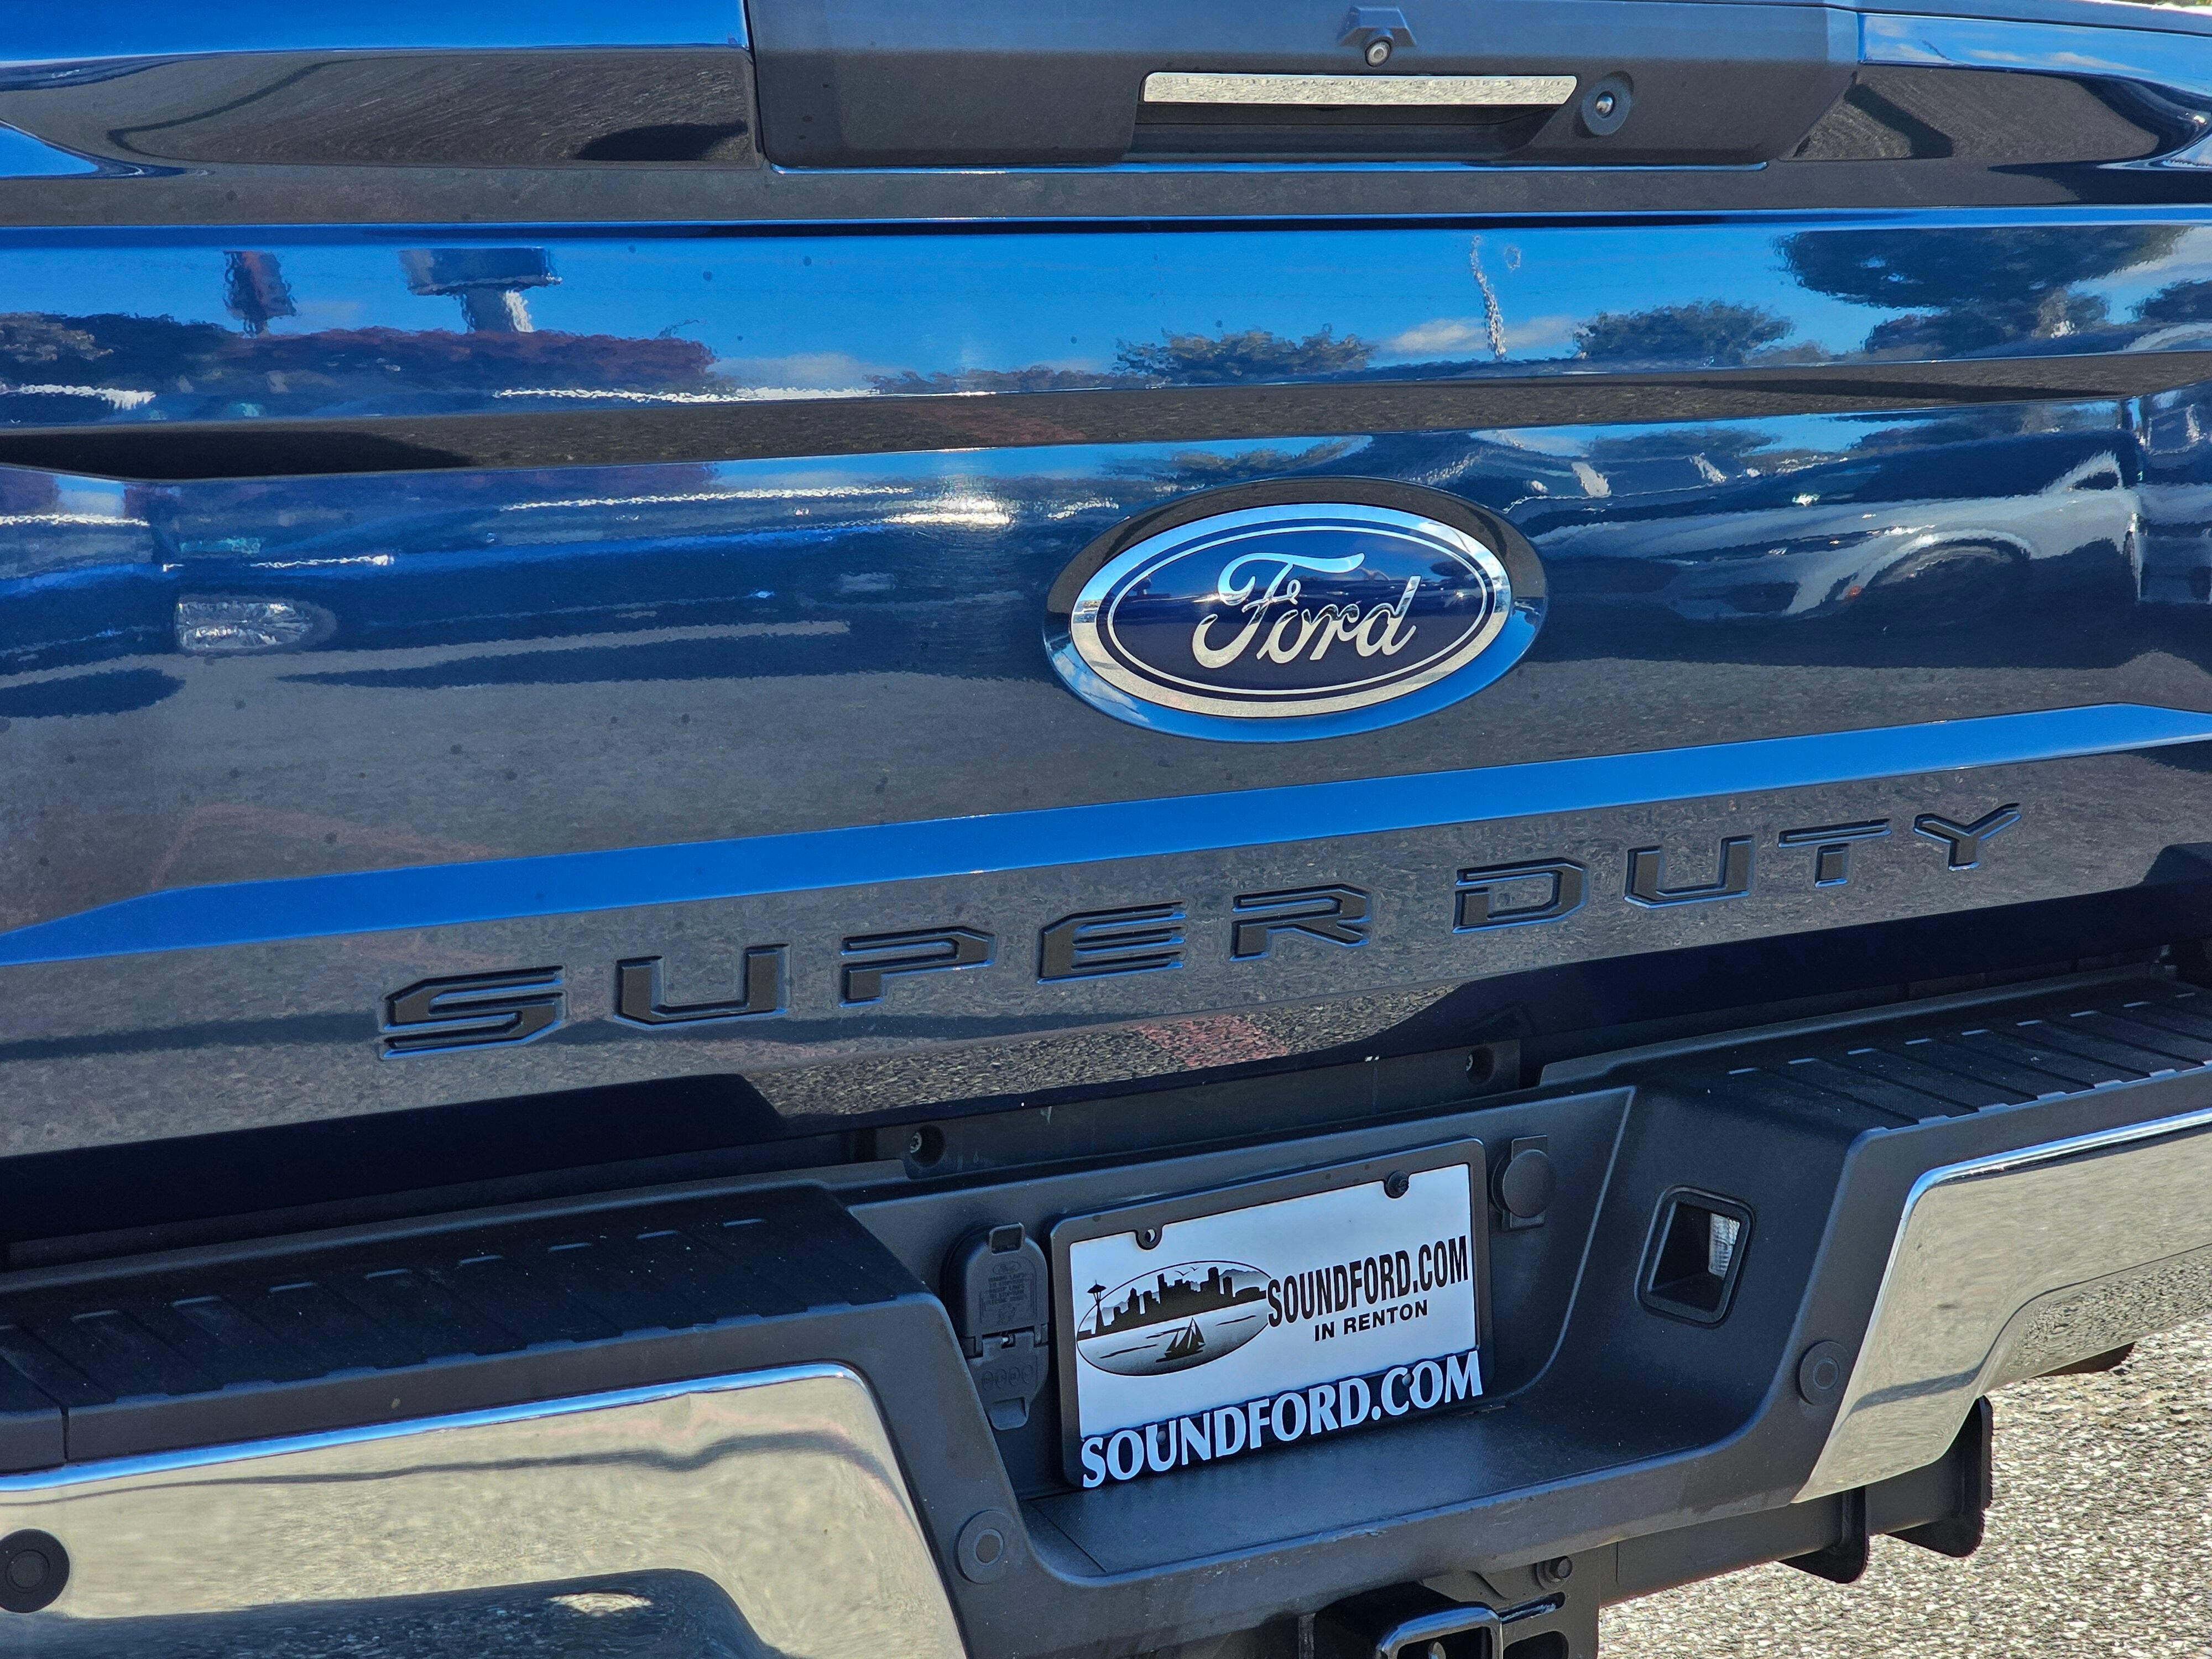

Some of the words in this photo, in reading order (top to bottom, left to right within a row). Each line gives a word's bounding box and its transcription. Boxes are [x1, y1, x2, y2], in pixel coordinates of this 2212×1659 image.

[1192, 552, 1422, 668] Ford
[380, 883, 1370, 1058] SUPER
[1452, 803, 2021, 933] DUTY
[1267, 1235, 1468, 1327] SOUNDFORD.COM
[1314, 1321, 1335, 1342] IN
[1344, 1300, 1427, 1335] RENTON
[1082, 1350, 1483, 1488] SOUNDFORD.COM
